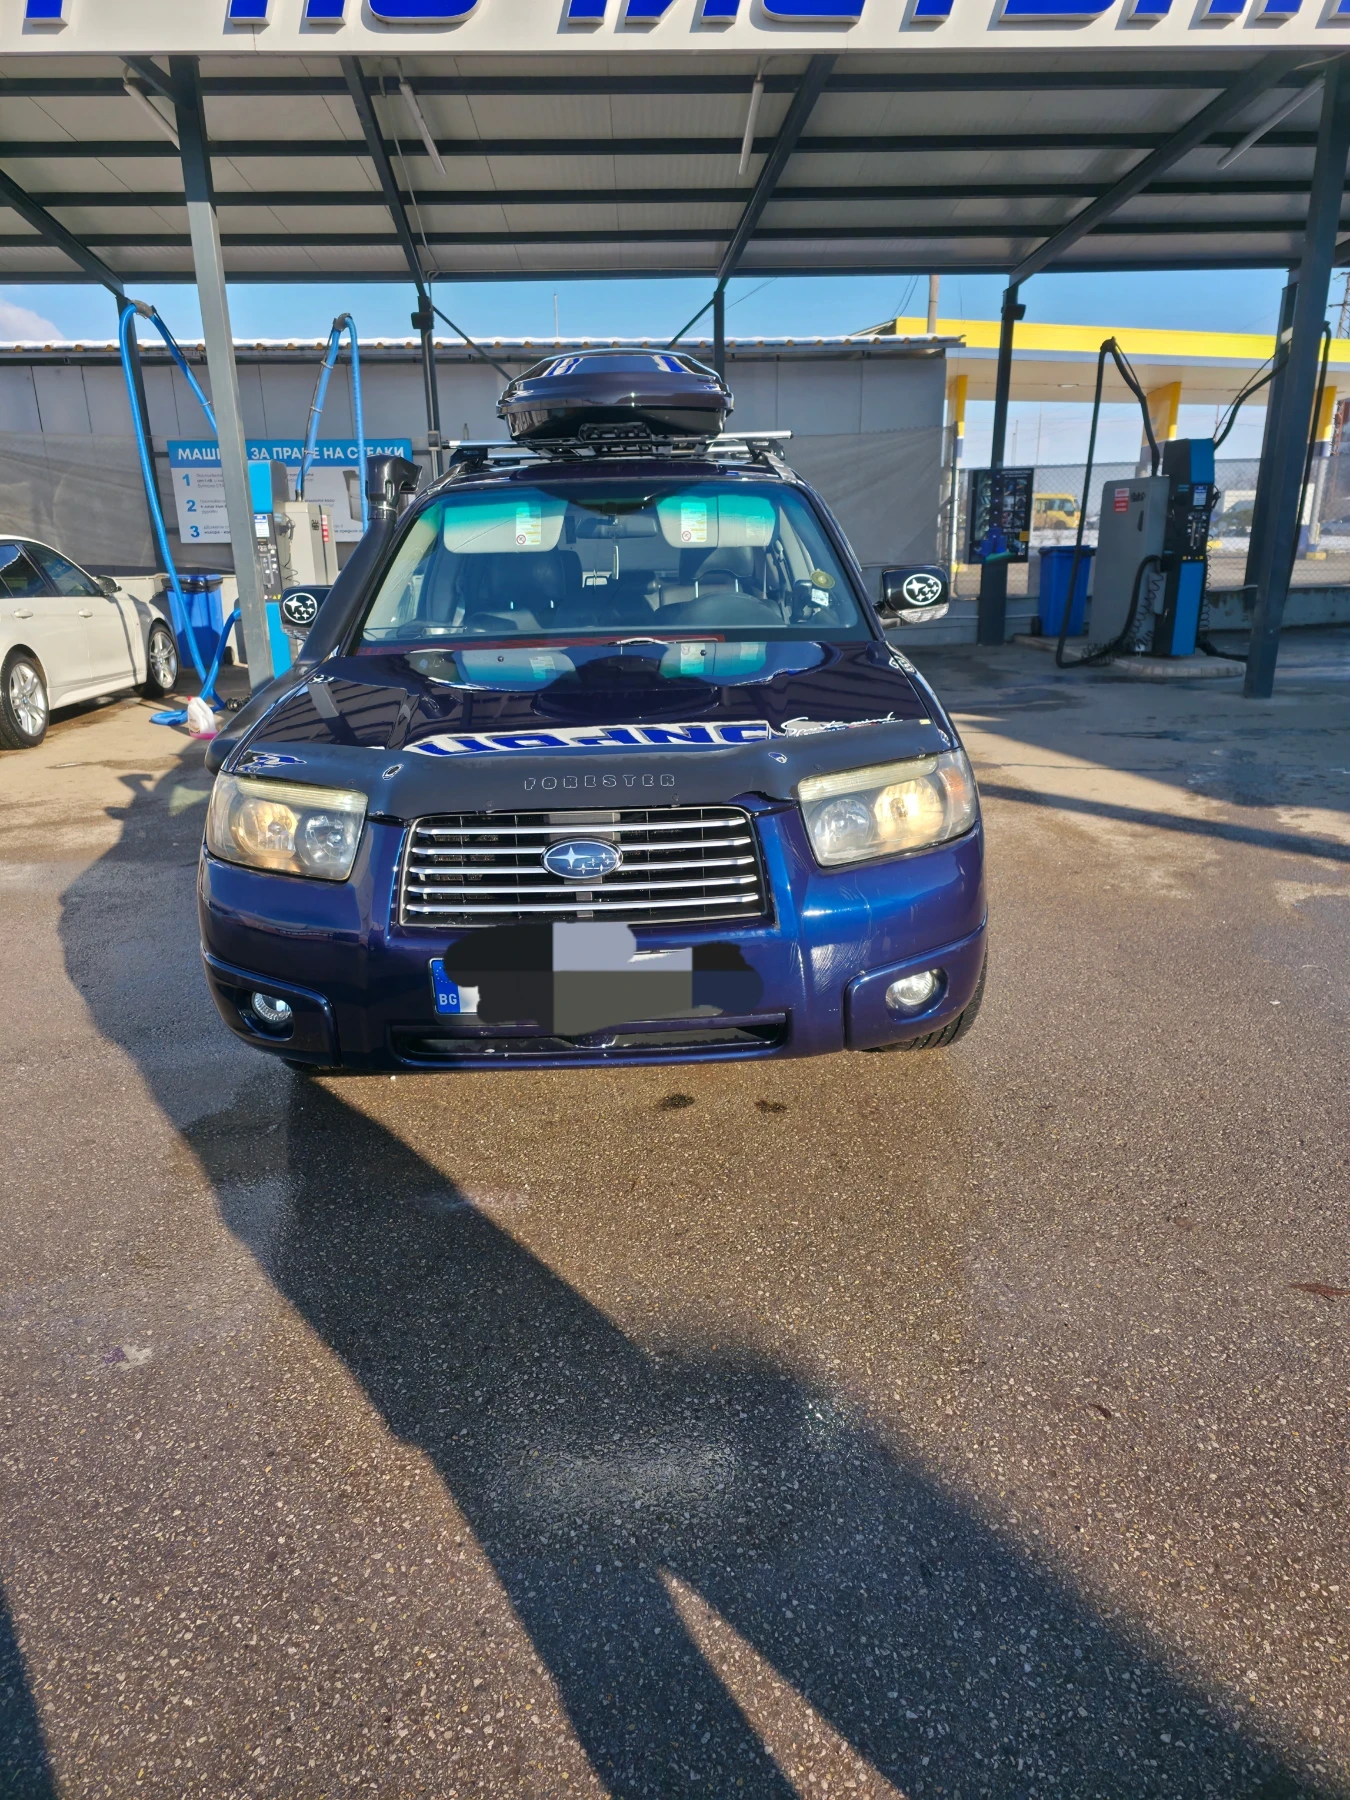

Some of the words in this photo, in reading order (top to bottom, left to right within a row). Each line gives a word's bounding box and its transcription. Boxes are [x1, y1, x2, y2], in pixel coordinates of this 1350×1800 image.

[178, 447, 248, 460] МАШ
[250, 447, 271, 460] ЗА
[323, 446, 345, 460] НА
[346, 446, 404, 459] СЕЛКИ
[182, 473, 191, 487] 1
[186, 499, 197, 512] 2
[189, 525, 200, 538] 3
[524, 774, 675, 790] FORESTER
[438, 993, 458, 1006] BG
